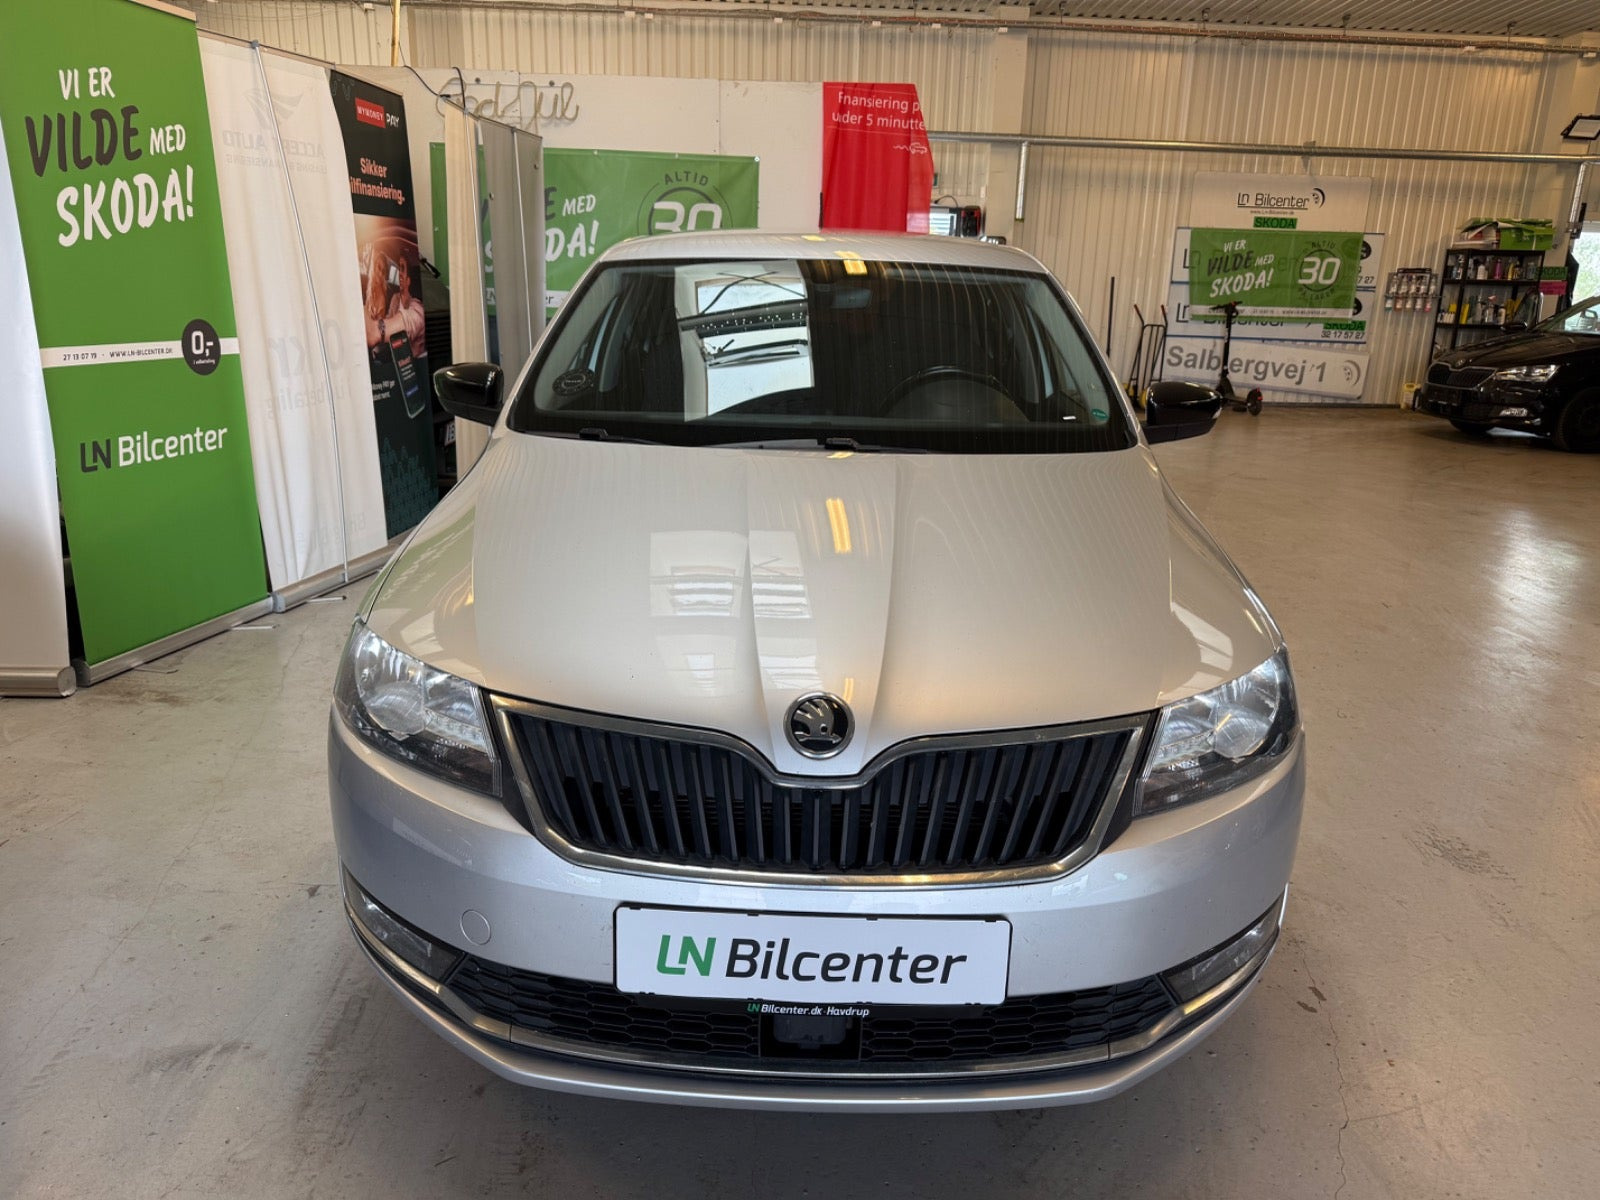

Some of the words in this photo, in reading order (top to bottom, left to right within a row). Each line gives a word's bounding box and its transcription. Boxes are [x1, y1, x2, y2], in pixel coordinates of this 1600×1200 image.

[58, 68, 80, 100] VI
[88, 66, 116, 98] ER
[838, 91, 909, 114] Fnansiering
[866, 113, 873, 127] 5
[24, 105, 142, 177] VILDE
[150, 124, 186, 156] MED
[360, 157, 388, 178] Sikker
[664, 170, 709, 186] ALTID
[350, 176, 406, 205] ilfinansiering.
[1254, 192, 1310, 208] Bilcenter
[56, 164, 194, 247] SKODA!
[562, 193, 597, 217] MED
[1255, 217, 1297, 229] SKODA
[1223, 242, 1233, 253] VI
[1234, 239, 1247, 250] ER
[1207, 250, 1254, 277] VILDE
[1254, 254, 1275, 267] MED
[1297, 256, 1342, 285] 30
[1209, 268, 1274, 298] SKODA!
[191, 330, 214, 357] 0,-
[1333, 331, 1343, 339] 17
[1355, 331, 1365, 340] 27
[63, 353, 71, 361] 27
[73, 353, 79, 361] 13
[81, 352, 89, 360] 07
[1166, 345, 1307, 386] Salbergvej
[1316, 361, 1327, 382] 1
[80, 438, 112, 473] LN
[118, 426, 228, 468] Bilcenter
[656, 933, 717, 977] LN
[725, 937, 968, 985] Bilcenter
[826, 1006, 870, 1018] Havdrup
